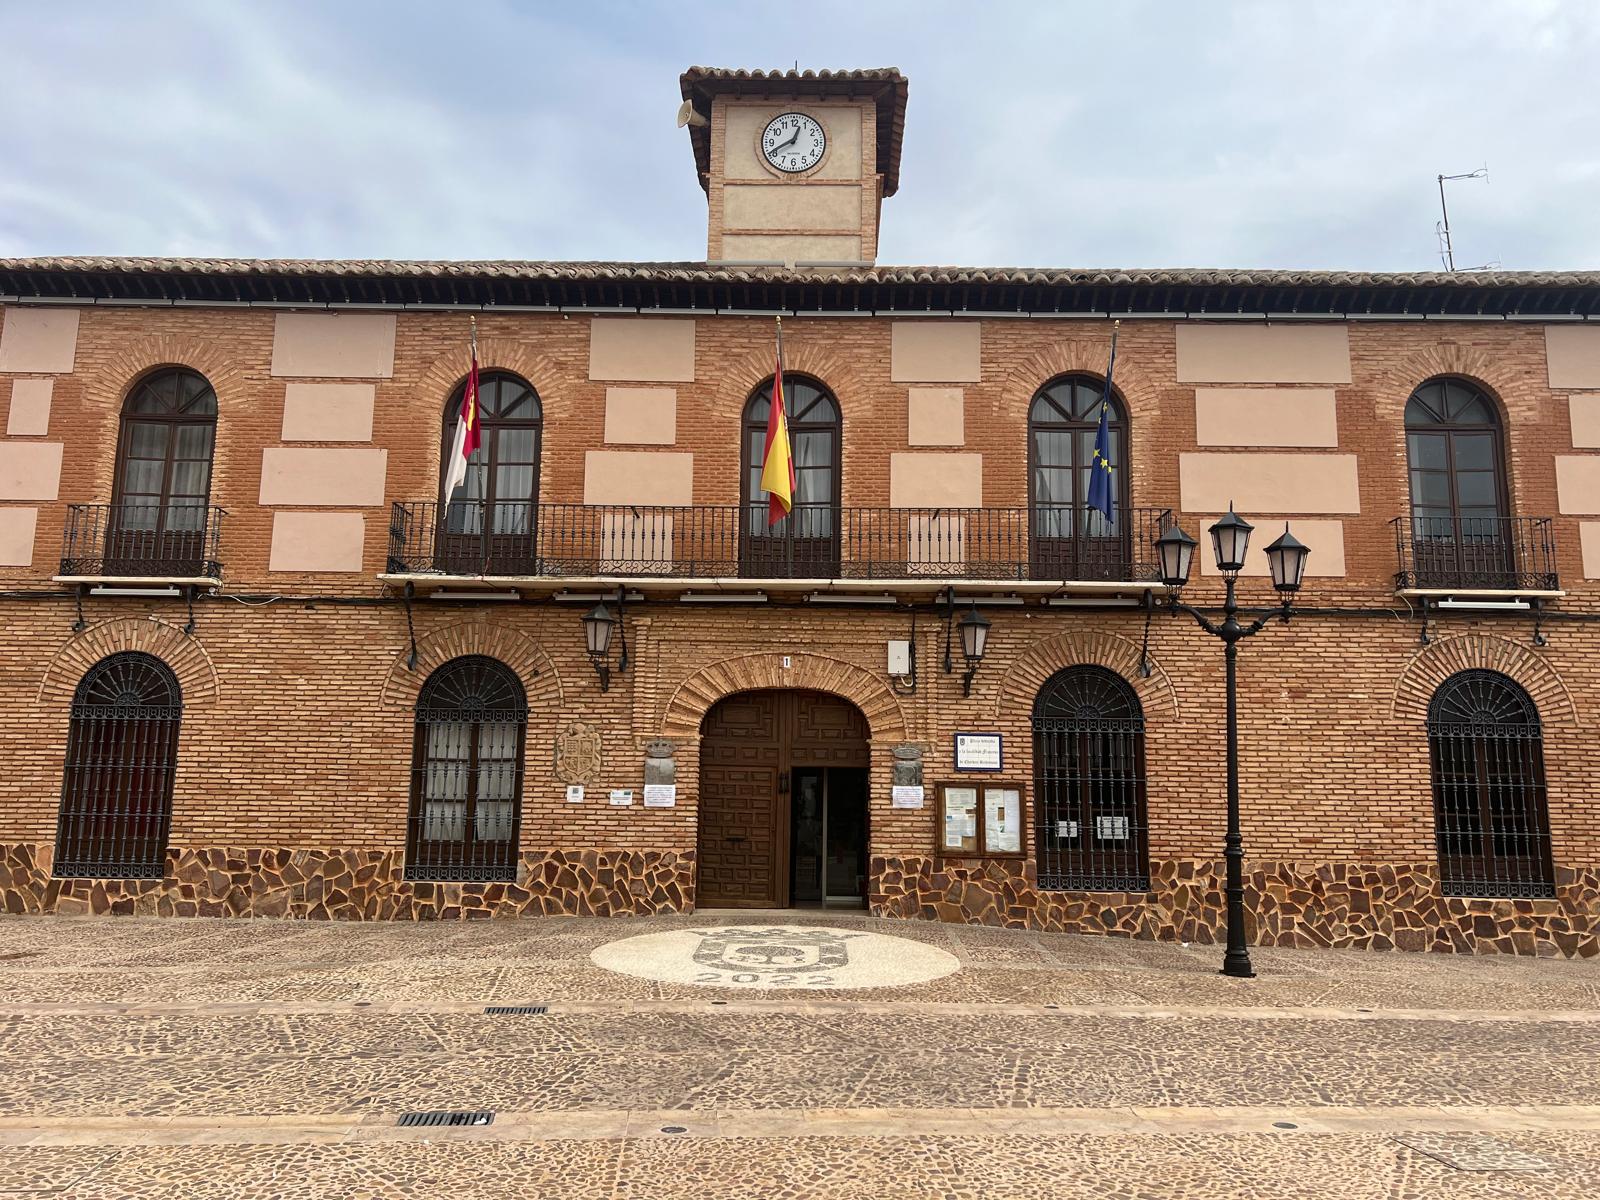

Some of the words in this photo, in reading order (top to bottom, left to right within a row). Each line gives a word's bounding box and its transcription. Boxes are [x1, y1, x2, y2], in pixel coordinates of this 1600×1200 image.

[781, 121, 787, 129] 11
[791, 119, 799, 127] 12
[773, 128, 781, 136] 10
[810, 128, 815, 136] 2
[769, 139, 774, 147] 9
[814, 139, 819, 147] 3
[810, 149, 815, 157] 4
[781, 156, 786, 164] 7
[791, 158, 796, 166] 6
[801, 156, 807, 164] 5
[693, 972, 835, 985] 2022
